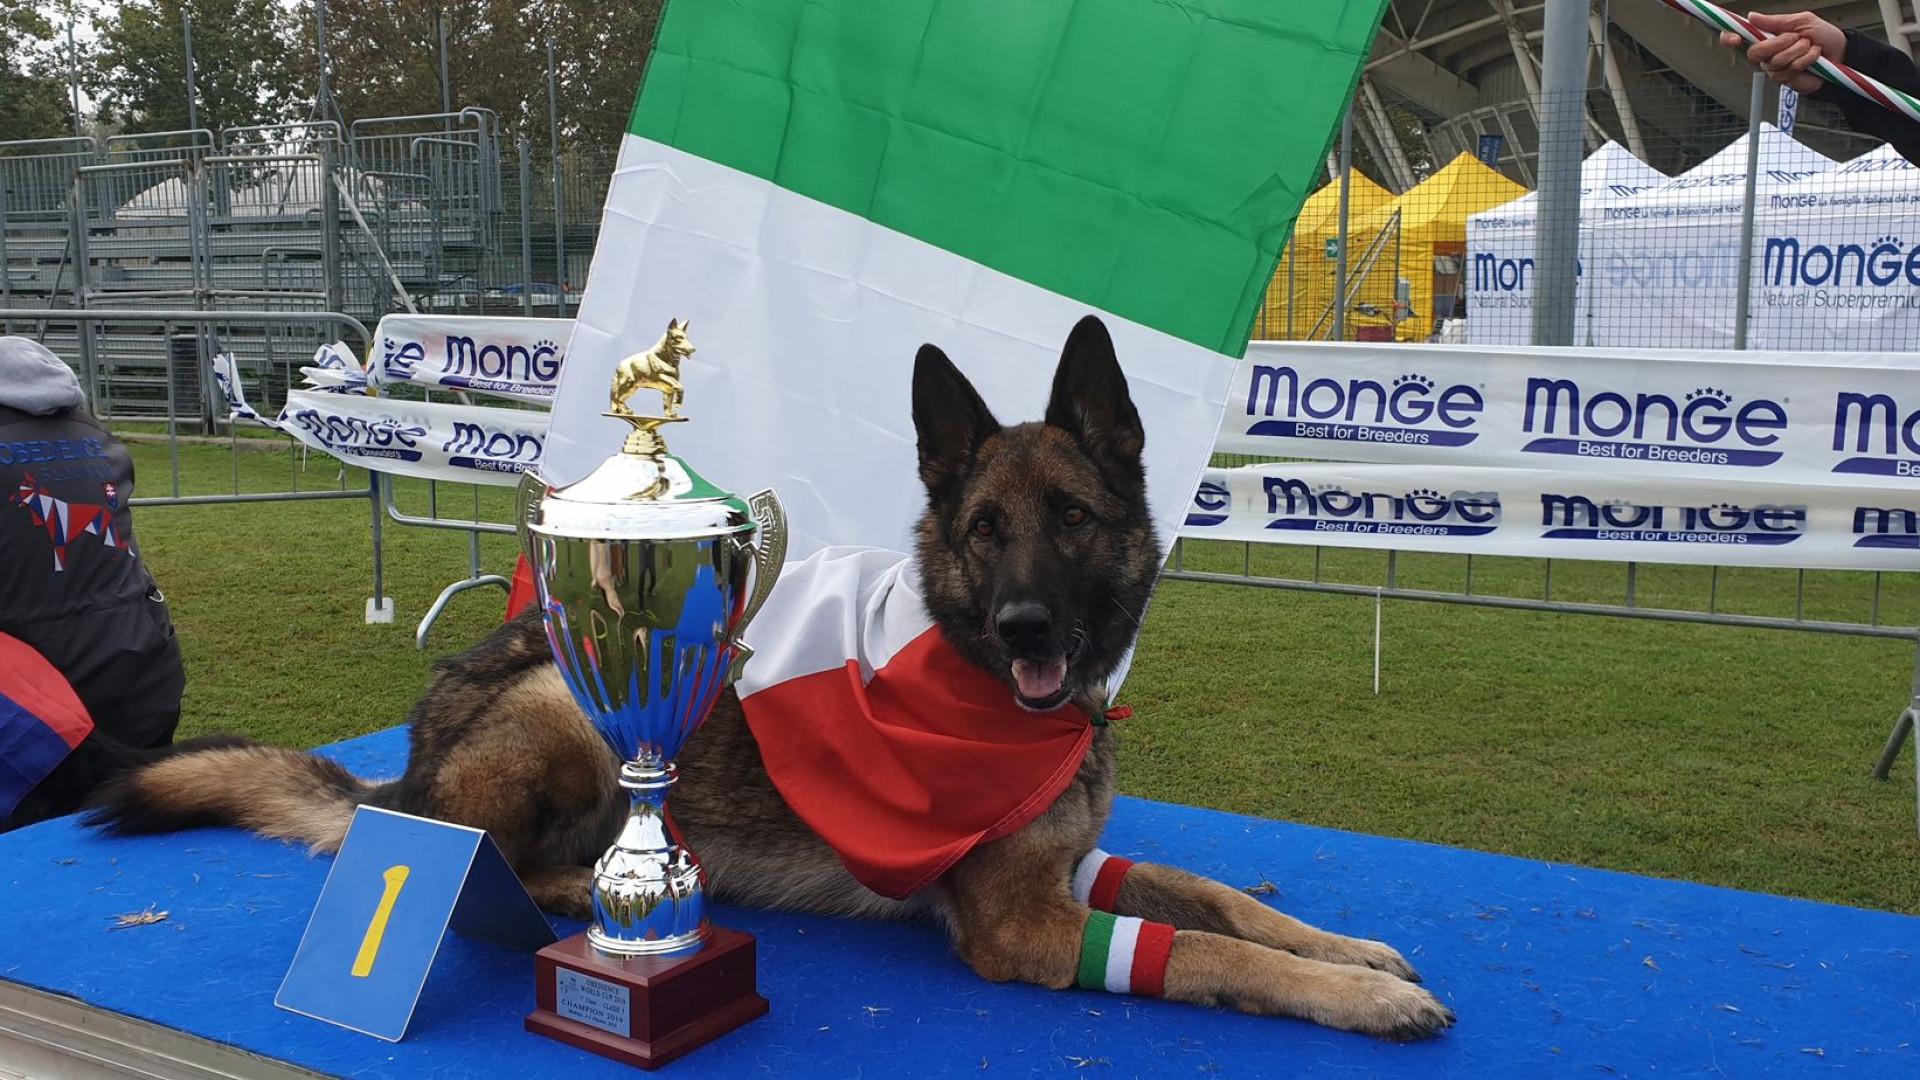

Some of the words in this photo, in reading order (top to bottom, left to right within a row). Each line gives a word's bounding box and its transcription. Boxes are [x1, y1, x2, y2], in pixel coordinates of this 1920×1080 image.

[1764, 289, 1810, 307] Natural
[442, 335, 563, 382] monG
[469, 378, 492, 389] Best
[493, 381, 507, 391] for
[443, 422, 545, 462] mon
[1296, 422, 1331, 438] Best
[1332, 423, 1354, 440] for
[1357, 426, 1429, 445] Breeders
[1578, 441, 1617, 458] Best
[1620, 442, 1645, 460] for
[1648, 446, 1728, 465] Breeders
[474, 459, 497, 471] Best
[498, 459, 513, 472] for
[1315, 520, 1351, 533] Best
[1353, 521, 1374, 534] for
[1377, 523, 1449, 536] Breeders
[1597, 530, 1634, 540] Best
[1640, 531, 1661, 541] for
[1667, 531, 1748, 543] Breeders
[351, 865, 410, 978] 1
[561, 998, 604, 1017] CHAMPION
